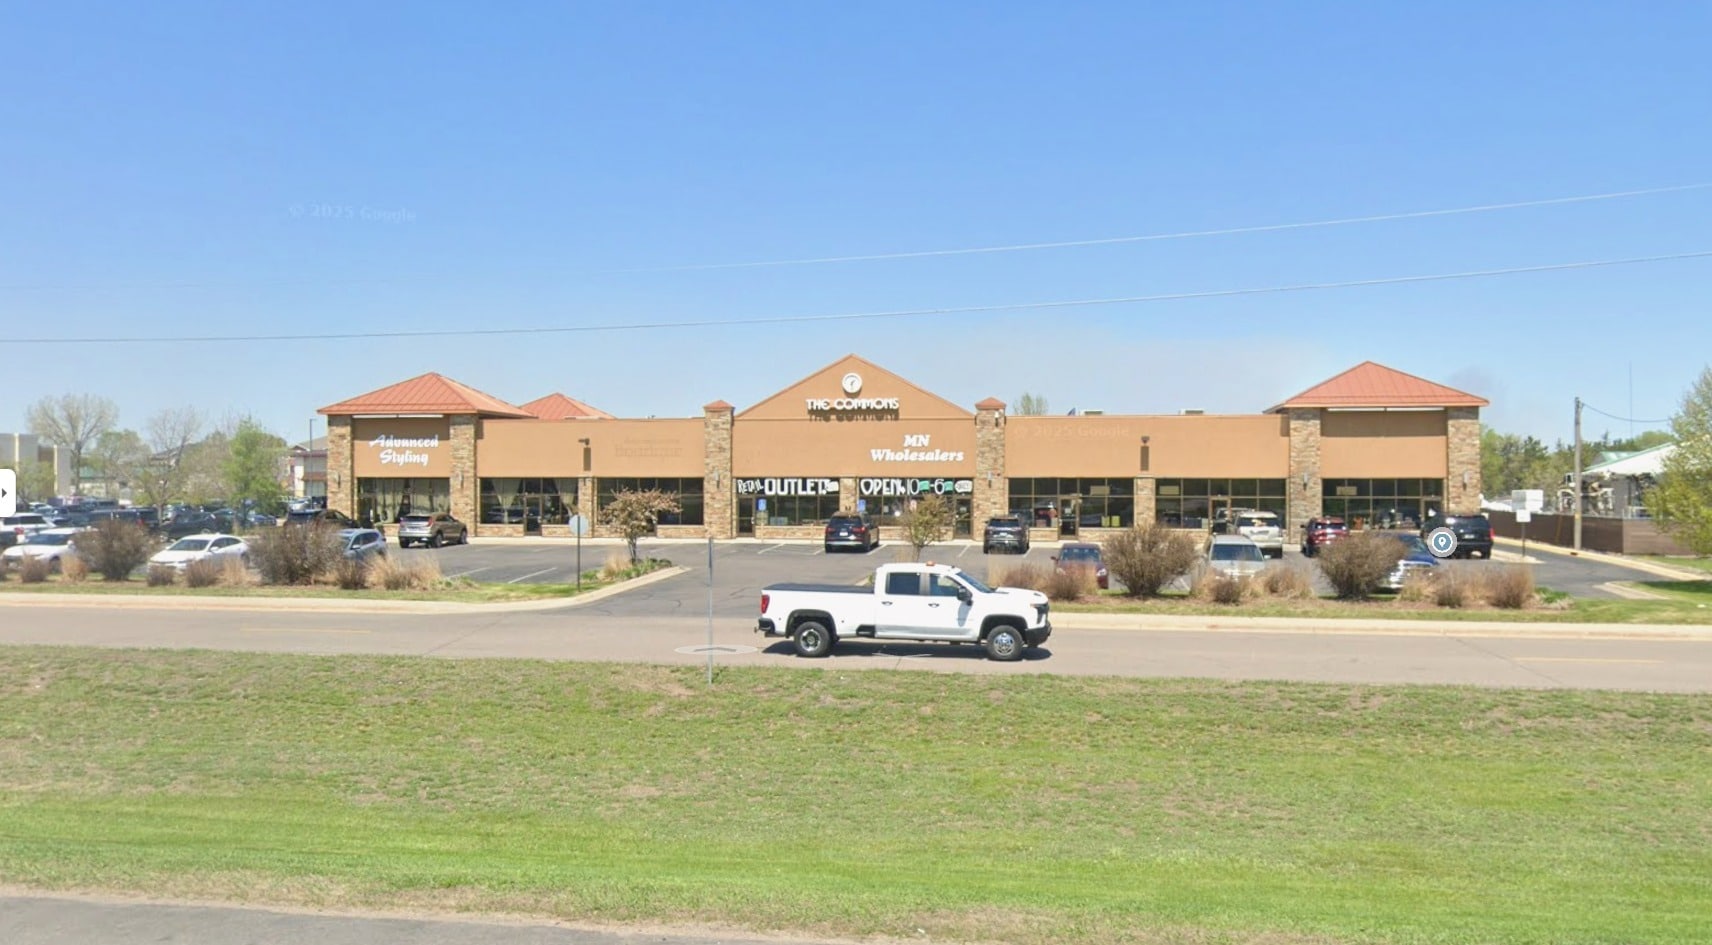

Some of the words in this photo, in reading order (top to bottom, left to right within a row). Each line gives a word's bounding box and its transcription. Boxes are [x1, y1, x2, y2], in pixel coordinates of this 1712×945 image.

[806, 399, 830, 411] THE
[834, 398, 900, 411] COMMONS
[369, 434, 439, 448] Advanced
[904, 434, 930, 447] MN
[380, 448, 429, 466] Styling
[870, 449, 964, 461] Wholesalers
